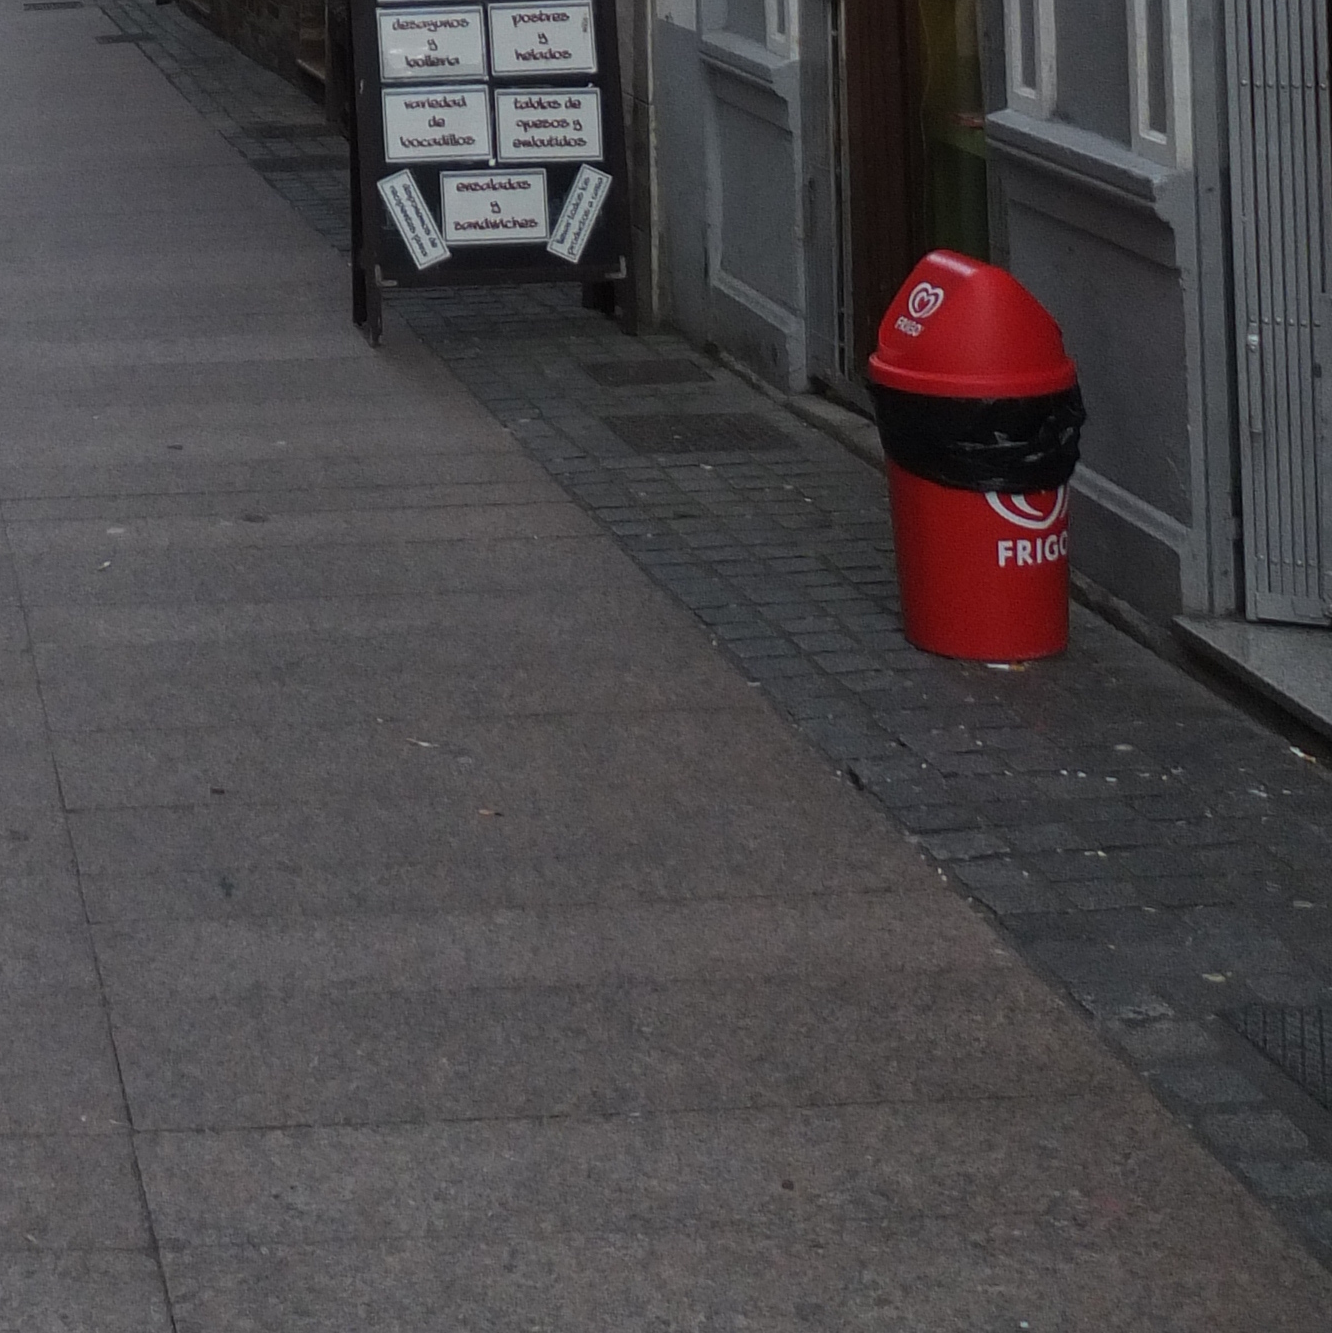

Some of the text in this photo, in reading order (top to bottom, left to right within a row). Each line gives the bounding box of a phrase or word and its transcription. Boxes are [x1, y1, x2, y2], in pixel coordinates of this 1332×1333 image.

[512, 10, 570, 27] postres
[392, 19, 469, 32] desayunos
[427, 39, 438, 51] y
[538, 33, 548, 44] y
[515, 48, 572, 61] helados
[403, 95, 467, 109] variedad
[514, 97, 581, 110] tablas de
[428, 116, 445, 127] de
[516, 119, 582, 132] quesos y
[400, 134, 475, 148] bocadillos
[513, 136, 587, 148] embutidos
[456, 178, 531, 192] ensaladas
[490, 201, 501, 214] y
[454, 217, 538, 231] sandwiches
